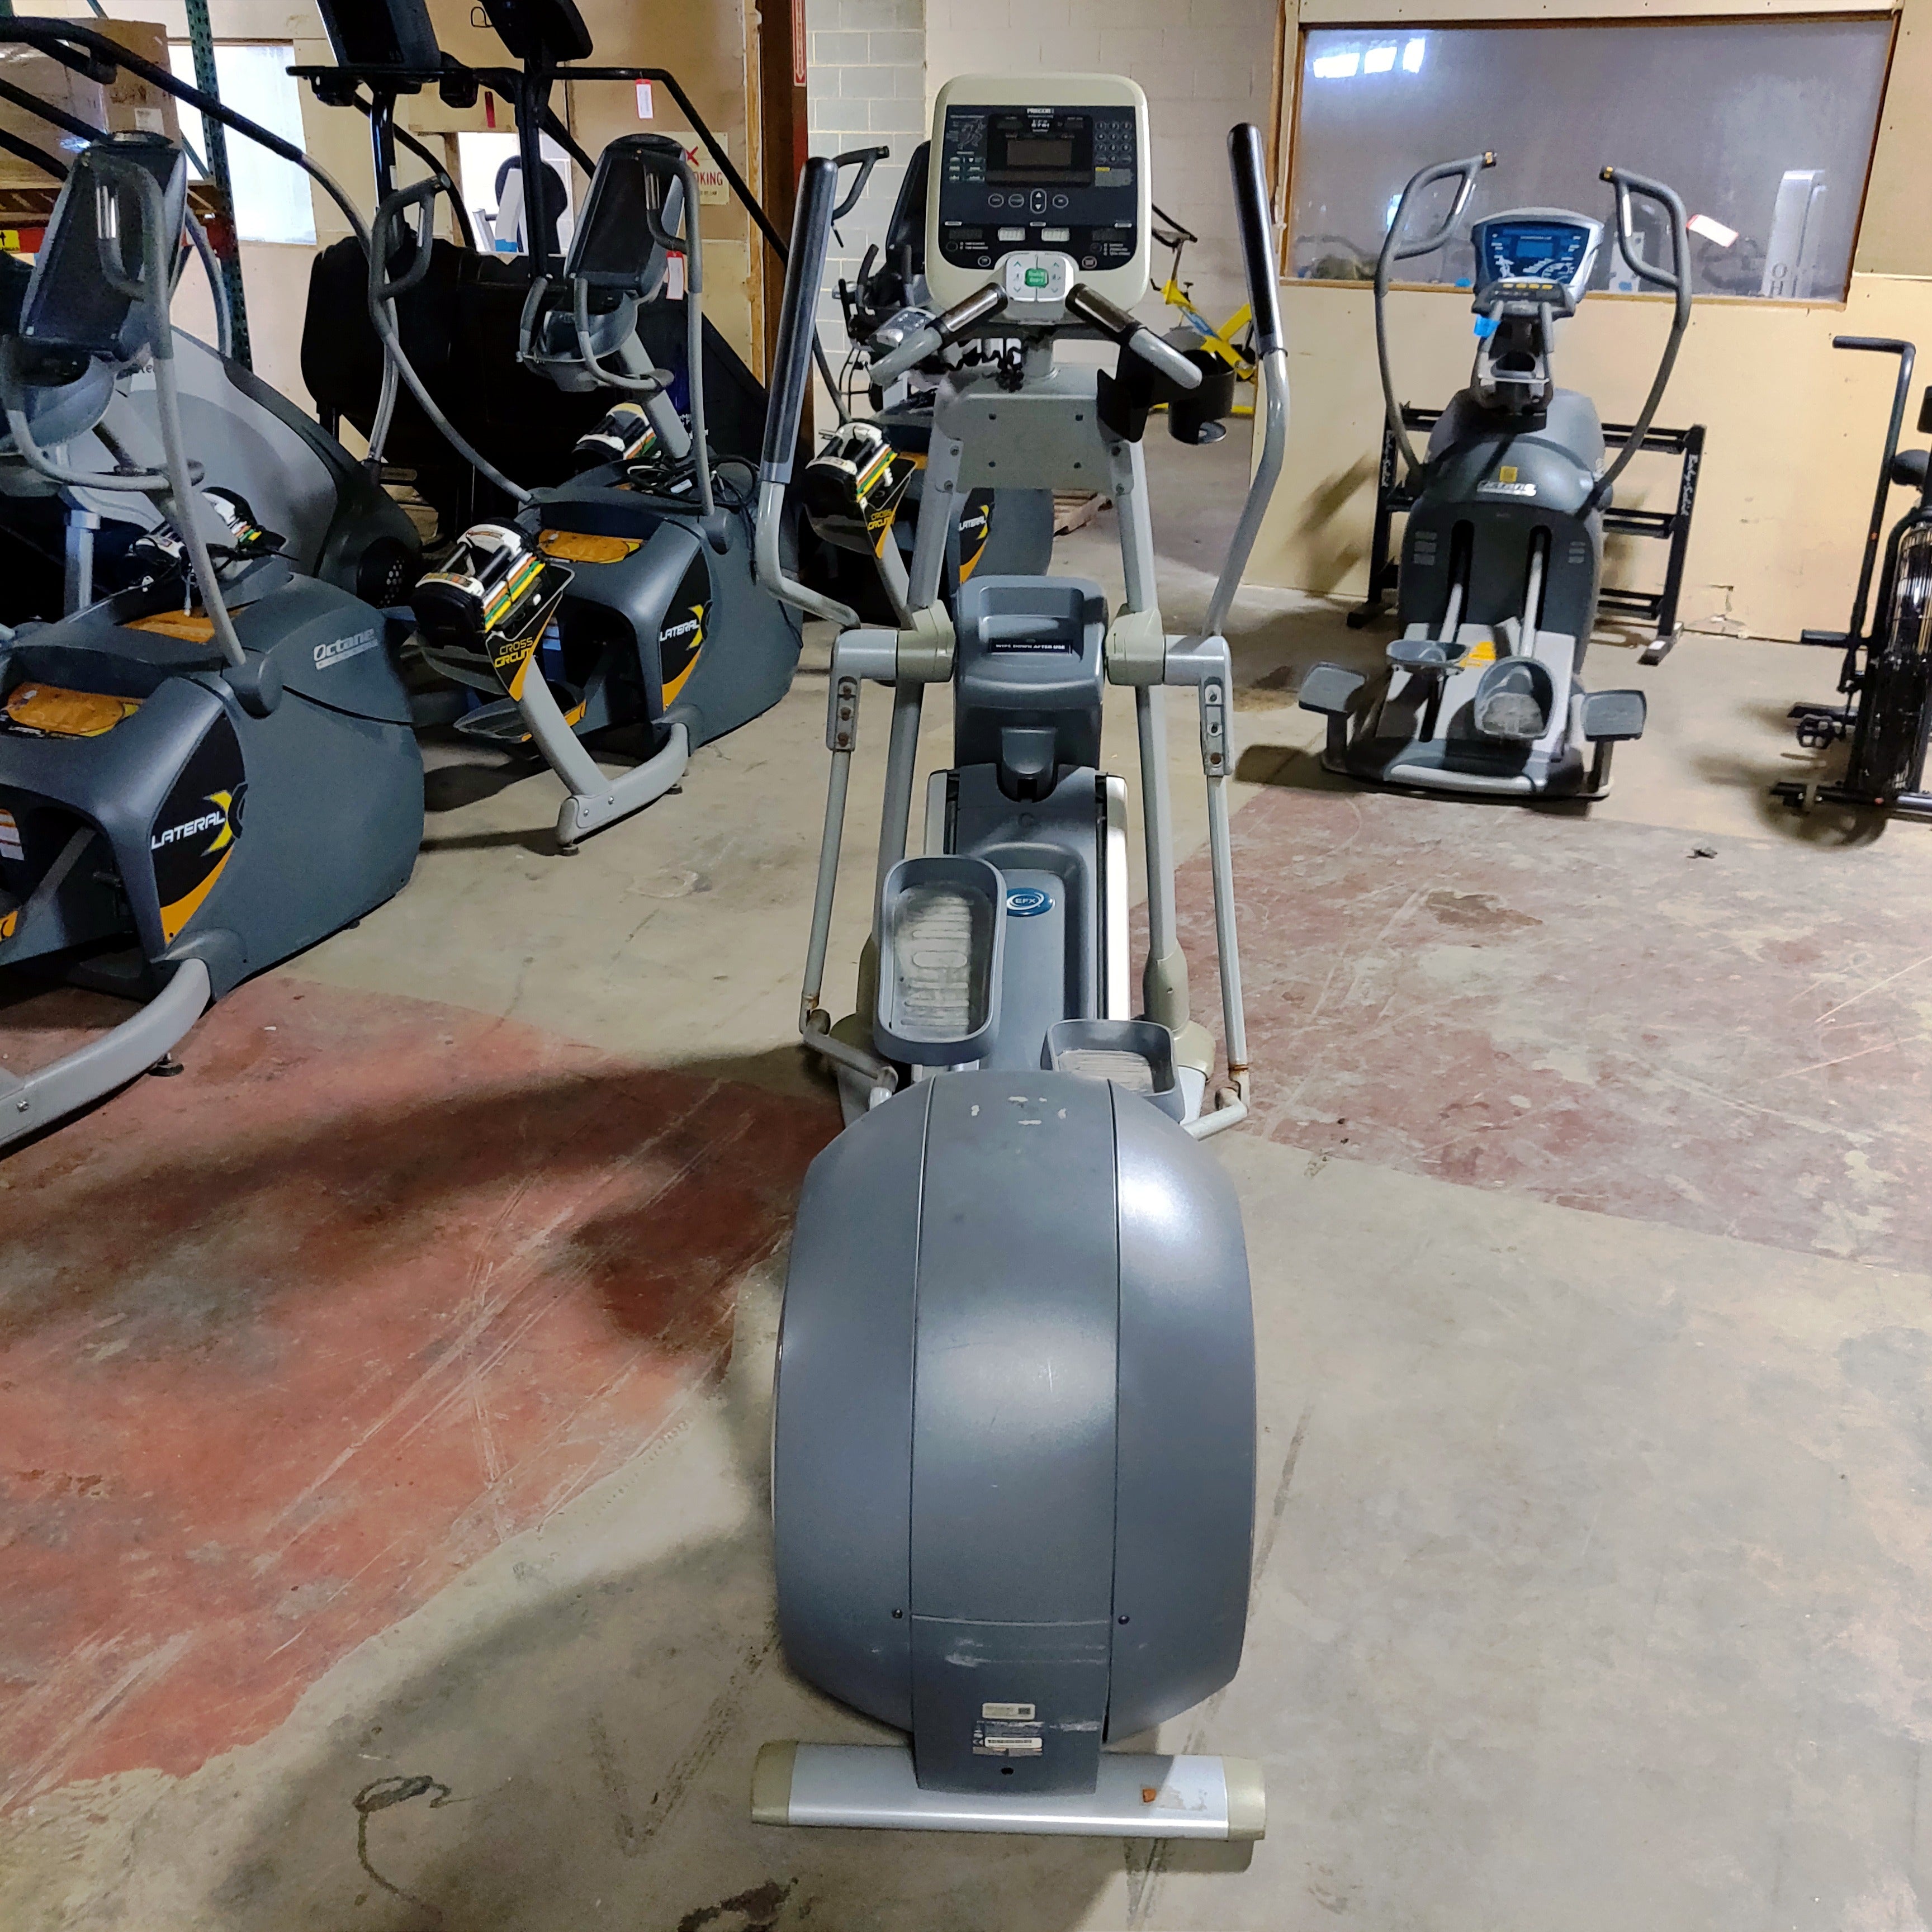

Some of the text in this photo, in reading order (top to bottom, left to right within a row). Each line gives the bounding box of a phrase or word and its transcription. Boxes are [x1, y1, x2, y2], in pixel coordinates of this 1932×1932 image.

[694, 171, 722, 186] OKING
[659, 619, 700, 642] LATERAL
[314, 628, 375, 662] Octane
[499, 636, 534, 656] CROSS
[151, 811, 226, 850] LATERAL
